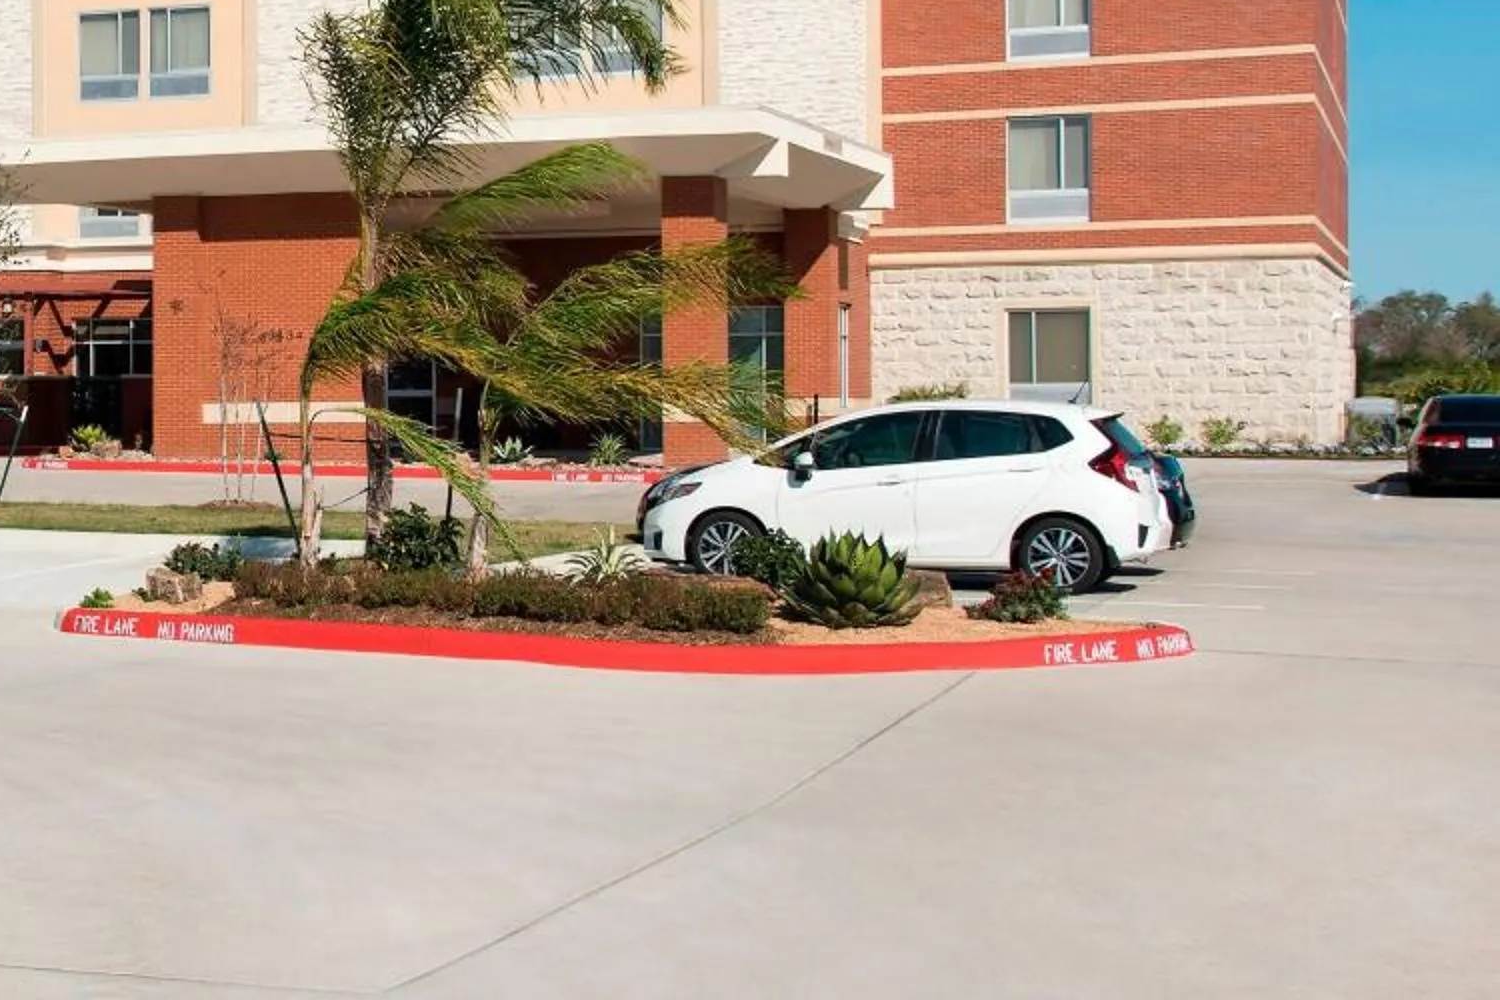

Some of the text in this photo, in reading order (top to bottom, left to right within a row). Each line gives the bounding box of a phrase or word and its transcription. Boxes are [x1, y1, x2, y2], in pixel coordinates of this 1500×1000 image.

[73, 615, 140, 636] FIRE LANE
[157, 619, 235, 643] NO PARKING
[1043, 640, 1120, 665] FIRE LANE
[1136, 637, 1155, 659] NO
